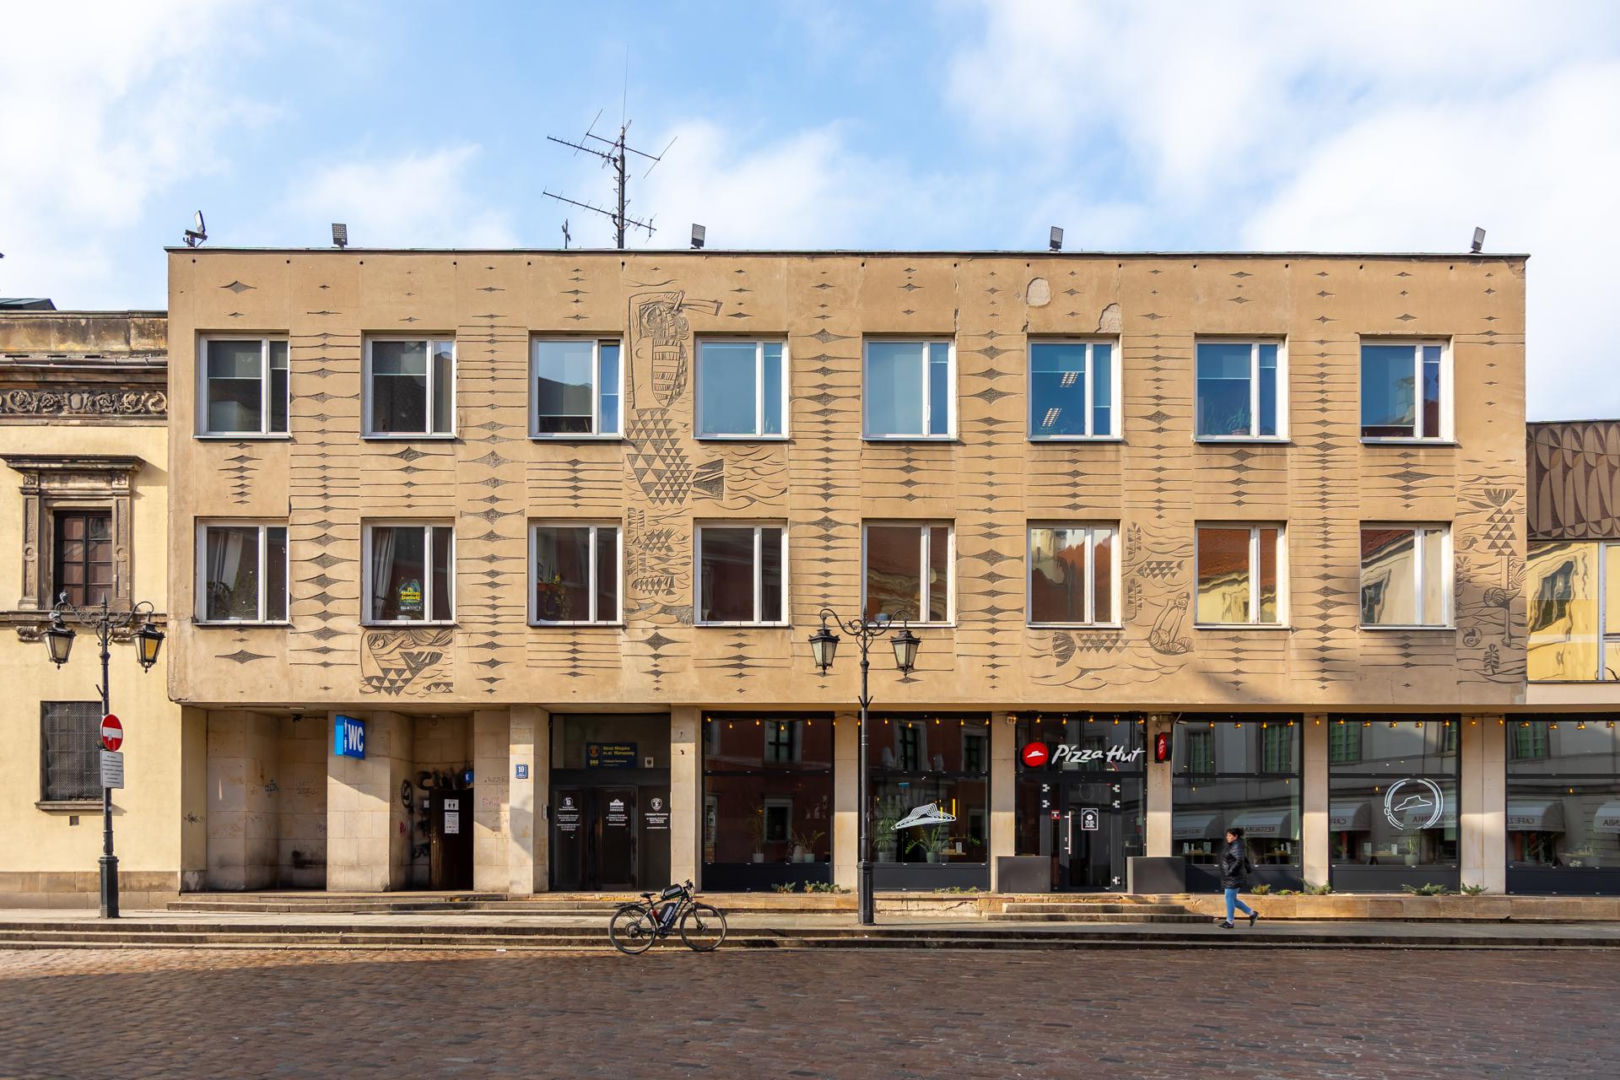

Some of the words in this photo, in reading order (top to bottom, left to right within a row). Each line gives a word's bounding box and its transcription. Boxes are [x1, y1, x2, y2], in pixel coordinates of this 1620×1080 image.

[348, 723, 364, 752] WC
[1051, 744, 1104, 765] Pizza
[1104, 744, 1146, 763] Hut
